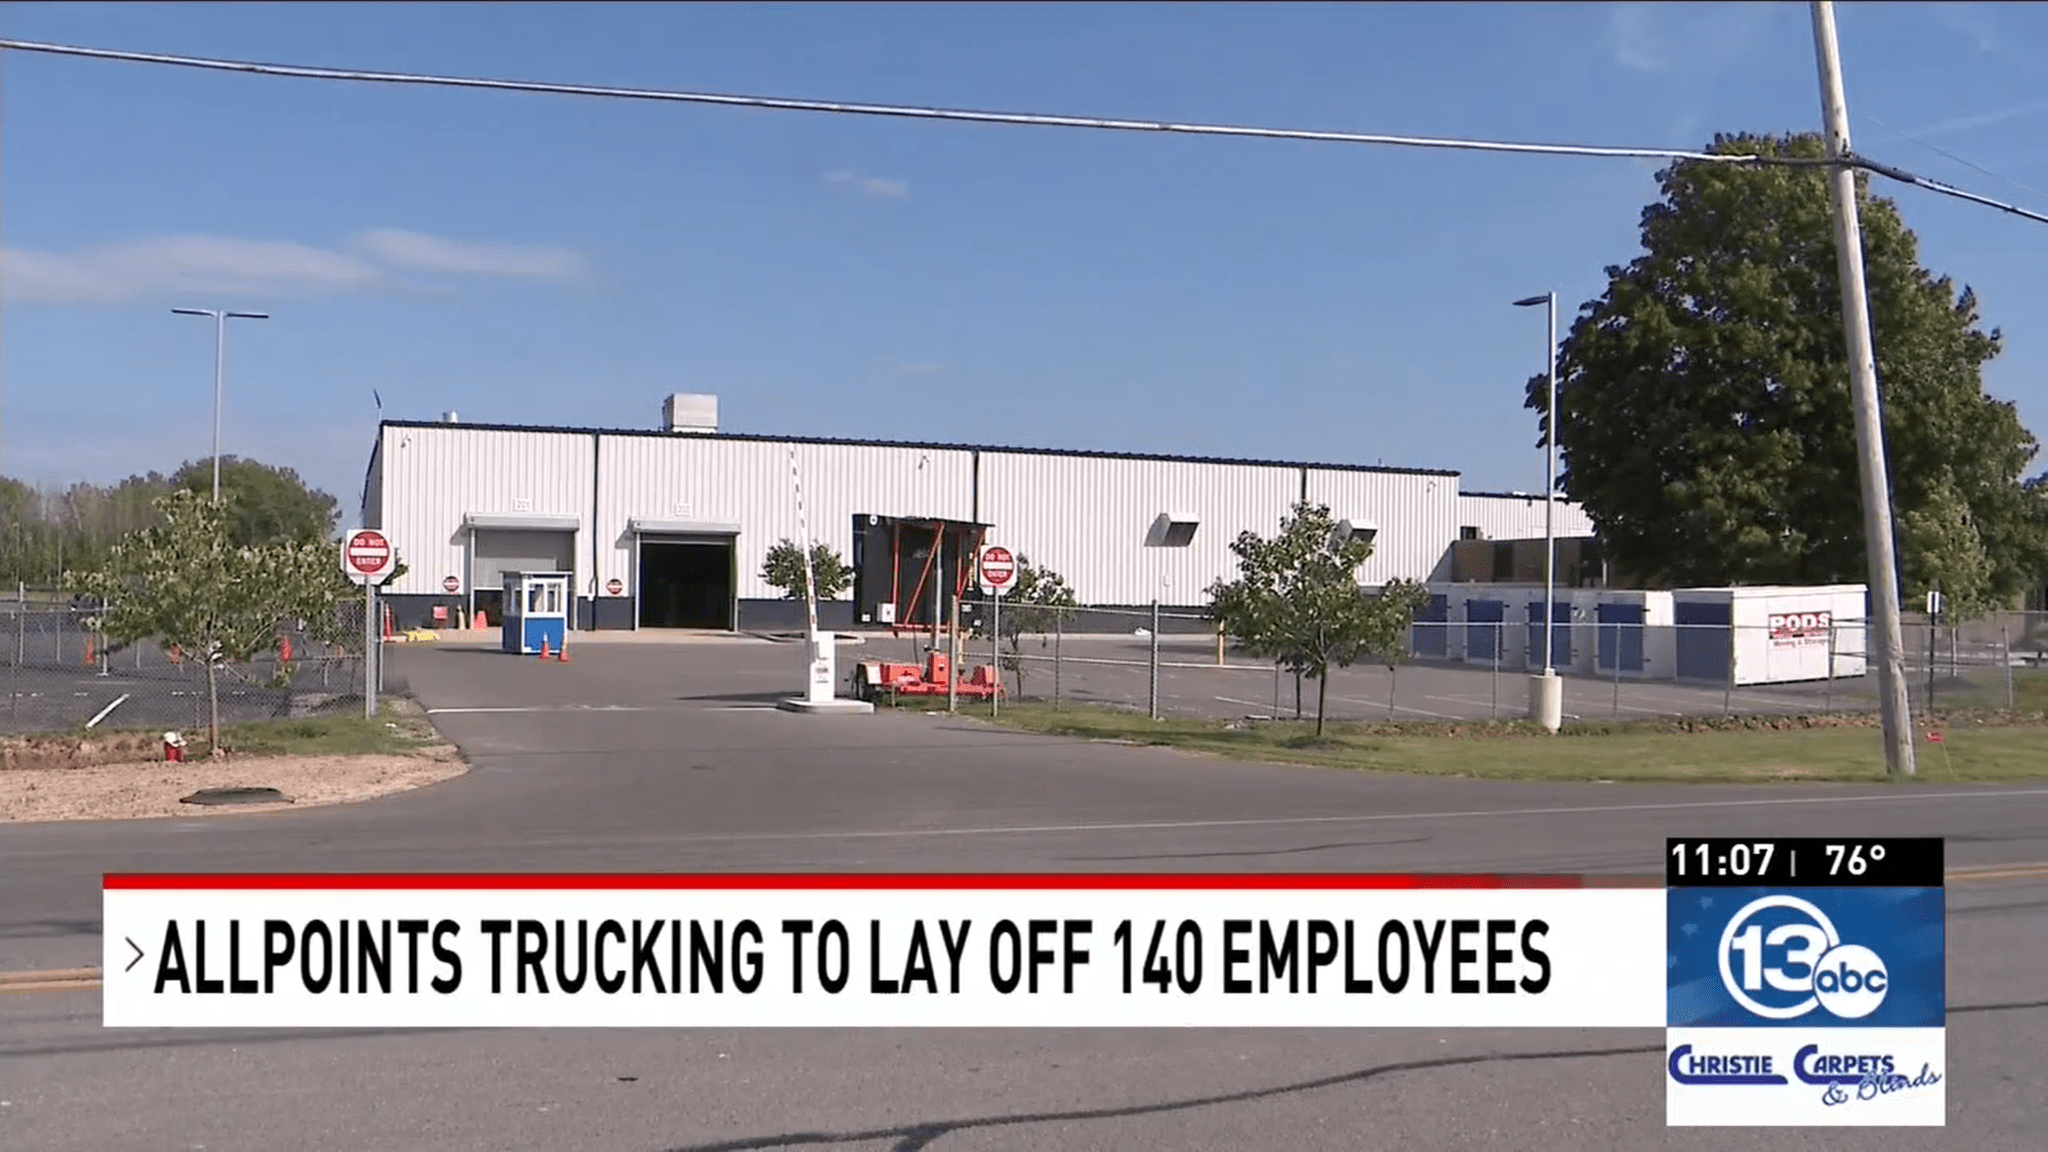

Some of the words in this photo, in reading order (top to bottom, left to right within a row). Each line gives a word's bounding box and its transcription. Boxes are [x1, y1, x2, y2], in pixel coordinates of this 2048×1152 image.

[353, 538, 365, 546] DO
[368, 538, 384, 546] NOT
[356, 557, 380, 565] ENTER
[985, 553, 995, 561] DO
[997, 553, 1010, 561] NOT
[987, 570, 1008, 578] ENTER
[1769, 612, 1830, 632] PODS
